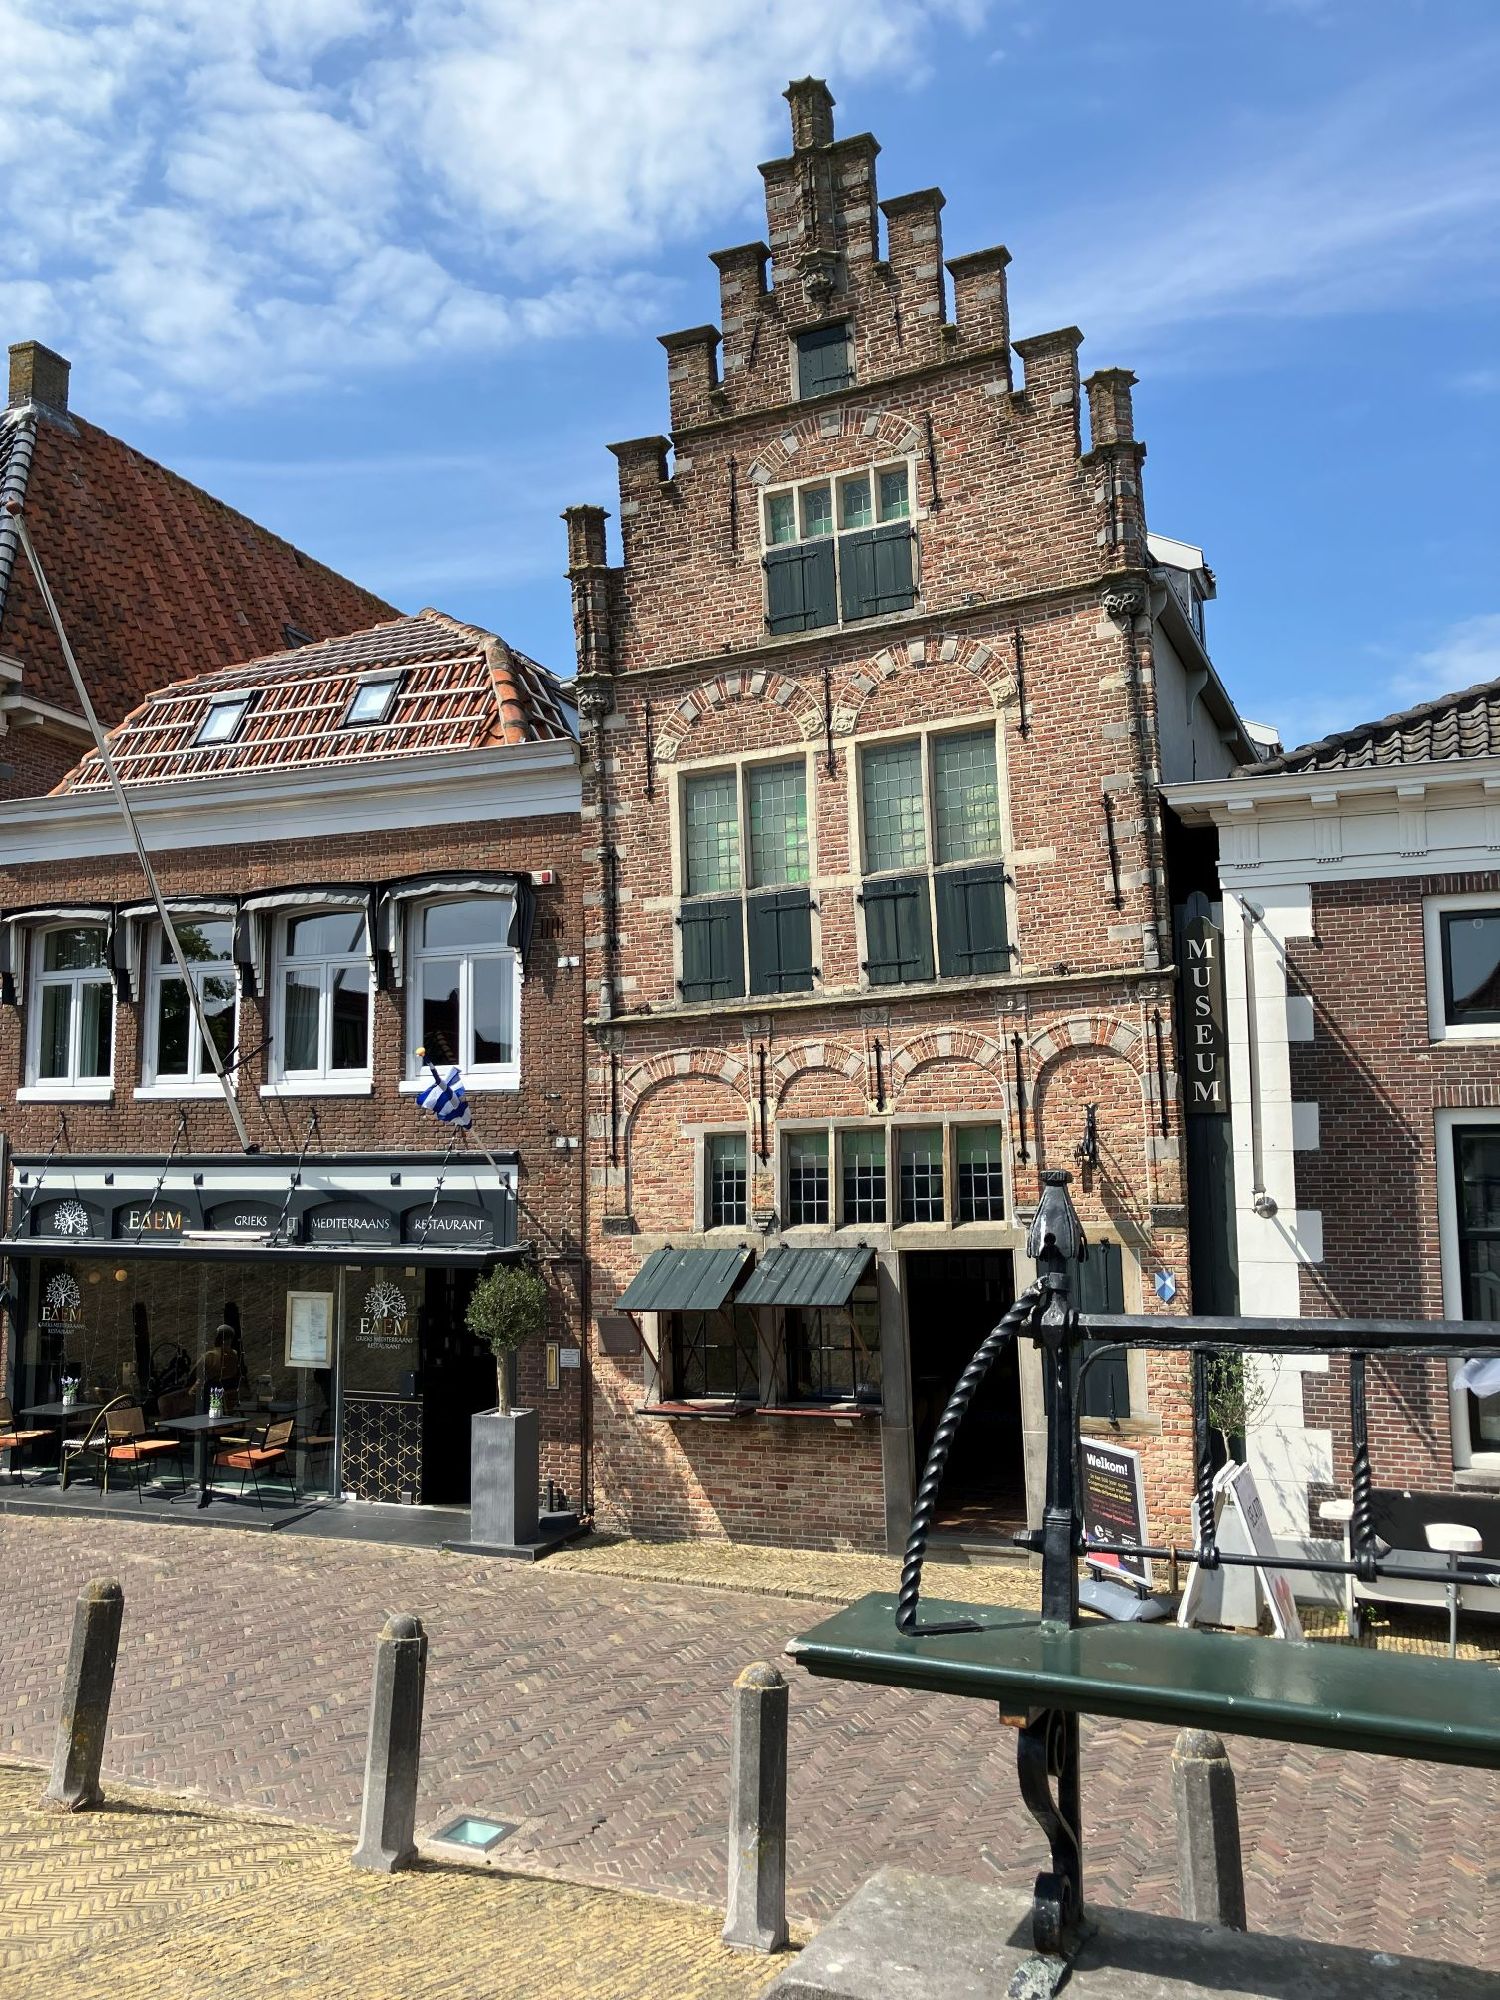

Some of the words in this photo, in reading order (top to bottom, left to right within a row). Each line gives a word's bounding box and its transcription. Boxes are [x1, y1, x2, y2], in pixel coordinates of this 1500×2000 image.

[1186, 937, 1222, 1102] MUSEUM
[234, 1215, 268, 1227] GRIEKS
[311, 1218, 390, 1229] MEDITERRAANS
[414, 1219, 485, 1231] RESTAURANT
[1086, 1452, 1128, 1476] Welkom!
